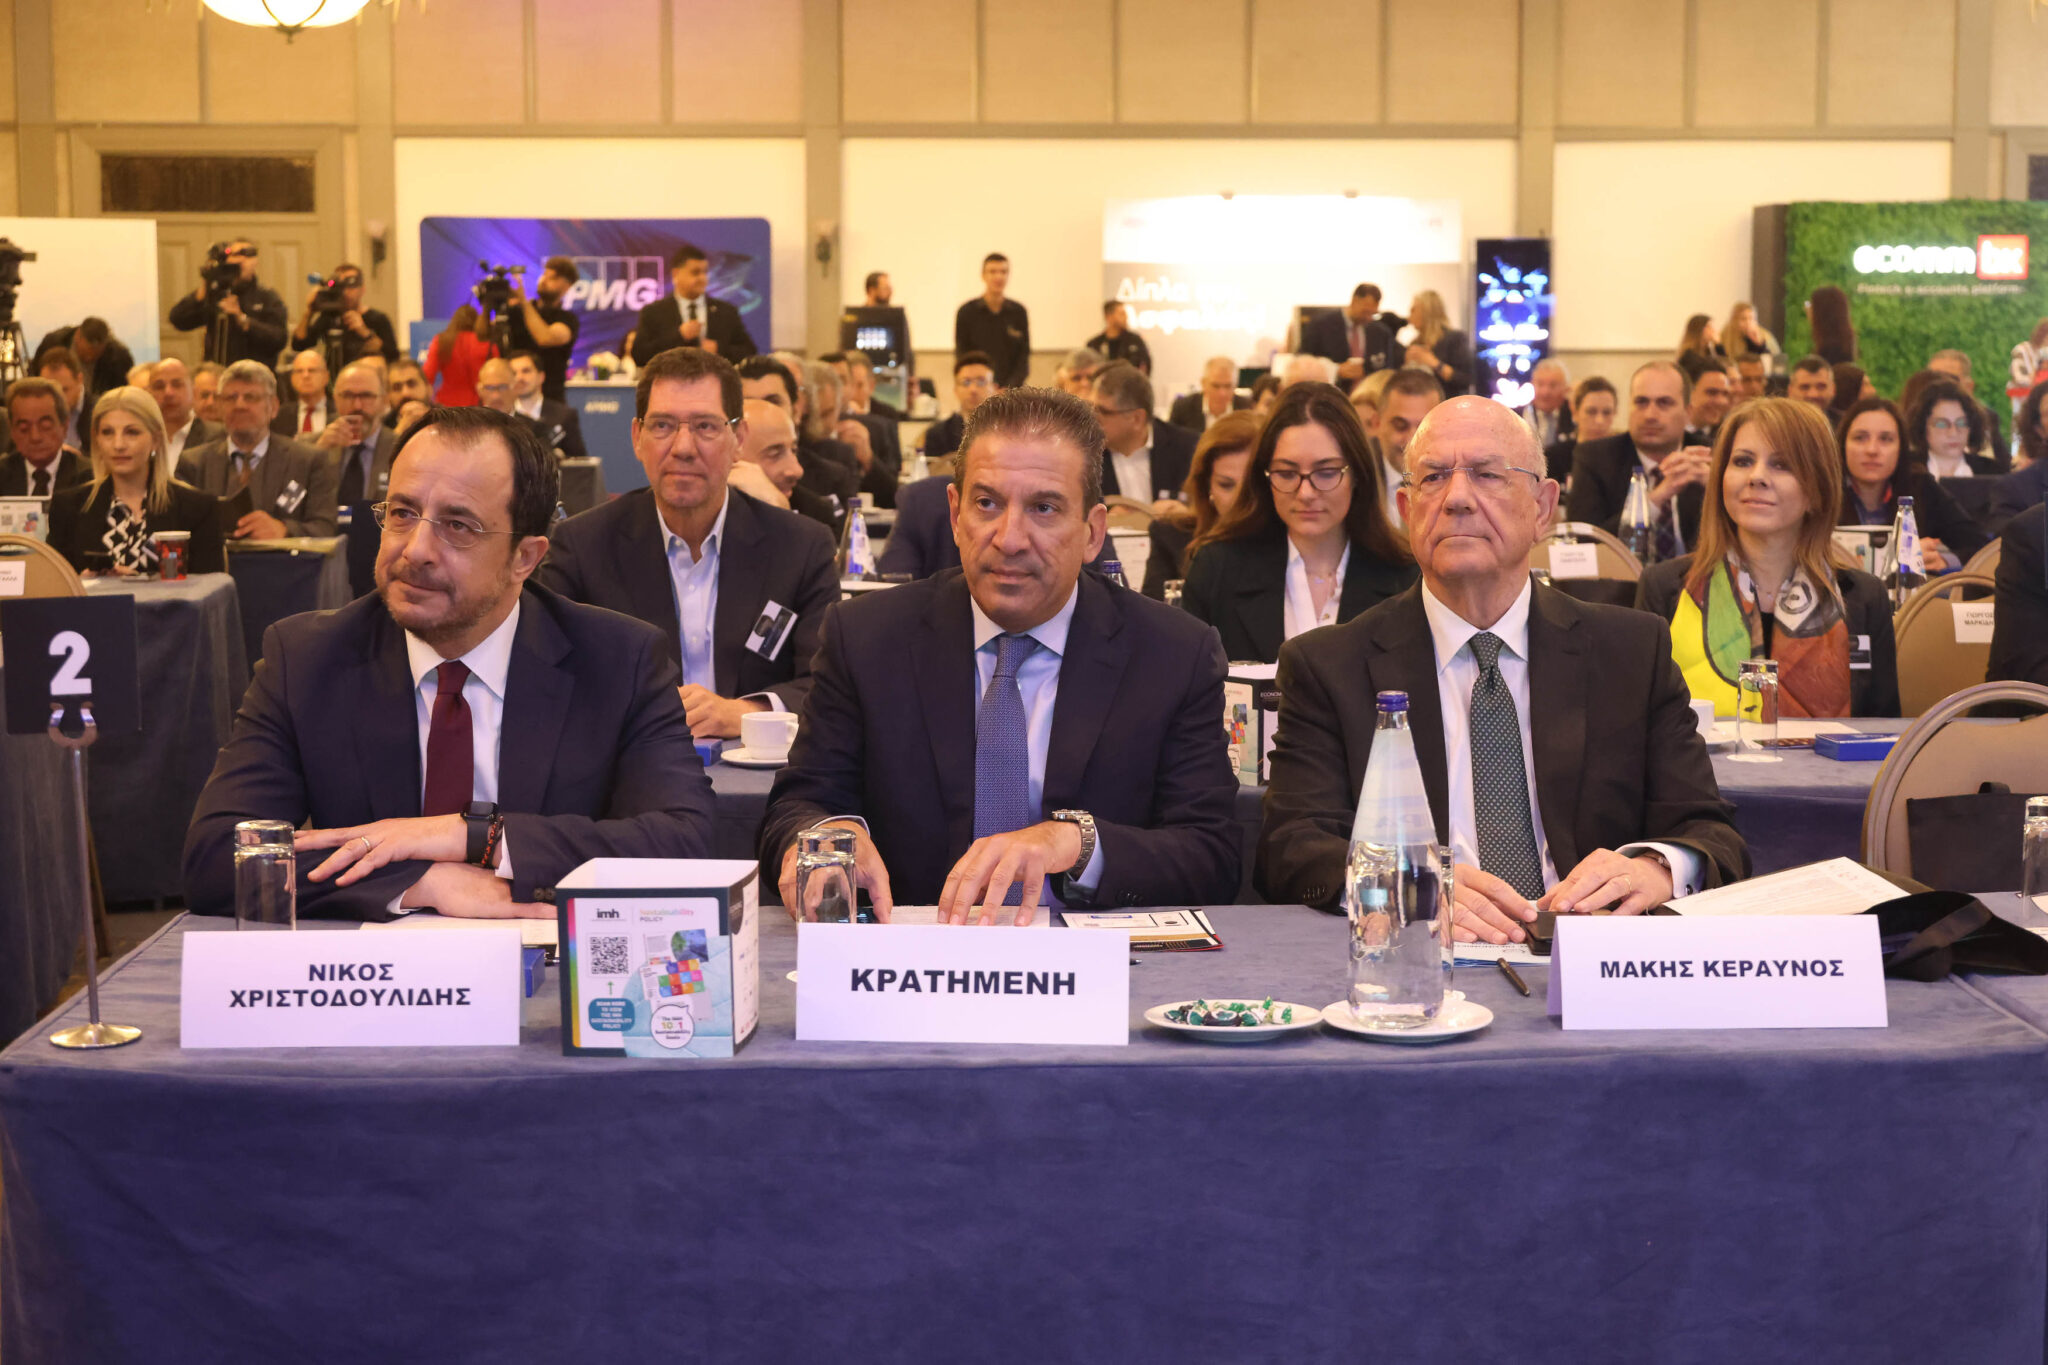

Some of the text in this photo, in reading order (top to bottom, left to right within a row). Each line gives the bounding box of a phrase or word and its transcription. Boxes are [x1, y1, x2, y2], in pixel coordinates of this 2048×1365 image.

[561, 277, 659, 311] PMG
[49, 630, 92, 696] 2
[596, 908, 620, 919] imh
[308, 963, 394, 982] ΝΙΚΟΣ
[1600, 959, 1844, 978] ΜΑΚΗΣ ΚΕΡΑΥΝΟΣ
[851, 968, 1075, 996] ΚΡΑΤΗΜΕΝΗ
[229, 987, 471, 1008] ΧΡΙΣΤΟΔΟΥΛΙΔΗΣ
